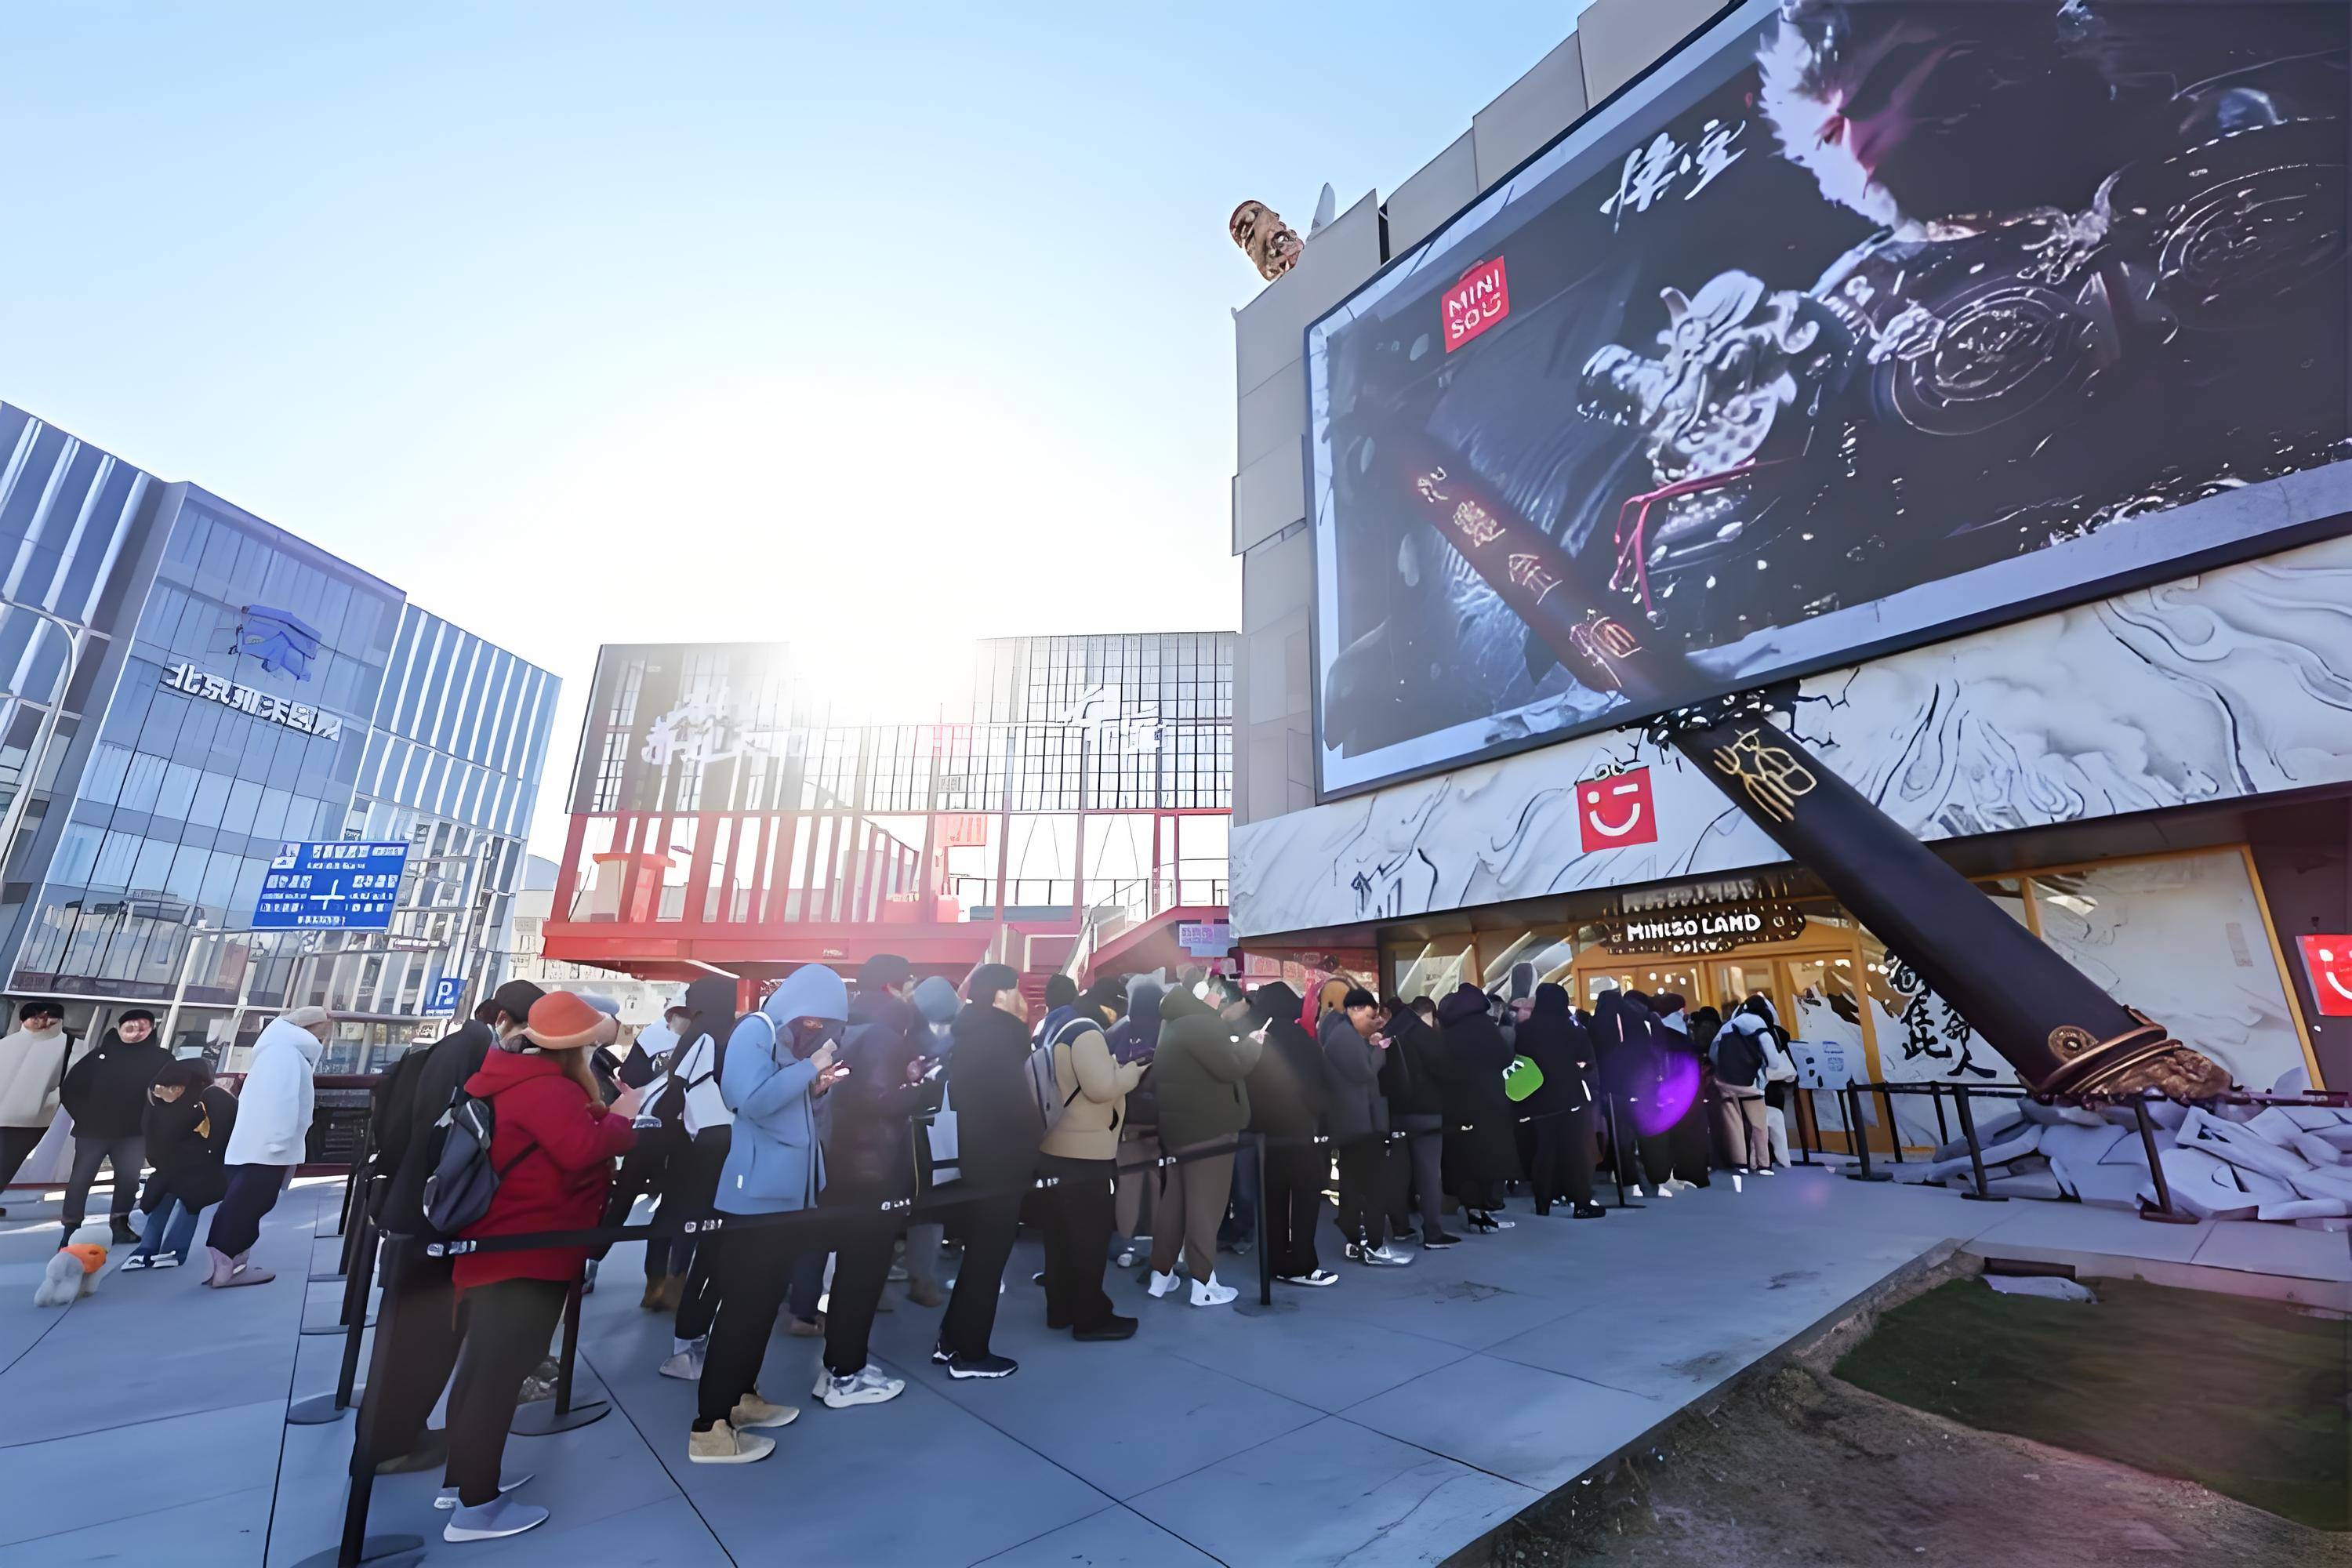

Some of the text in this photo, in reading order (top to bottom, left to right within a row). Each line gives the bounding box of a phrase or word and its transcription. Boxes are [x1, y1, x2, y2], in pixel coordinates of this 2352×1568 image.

[1599, 119, 1747, 234] 悟空
[1449, 269, 1500, 318] MINI
[1627, 914, 1761, 942] MINISO LAND
[434, 981, 453, 1007] P
